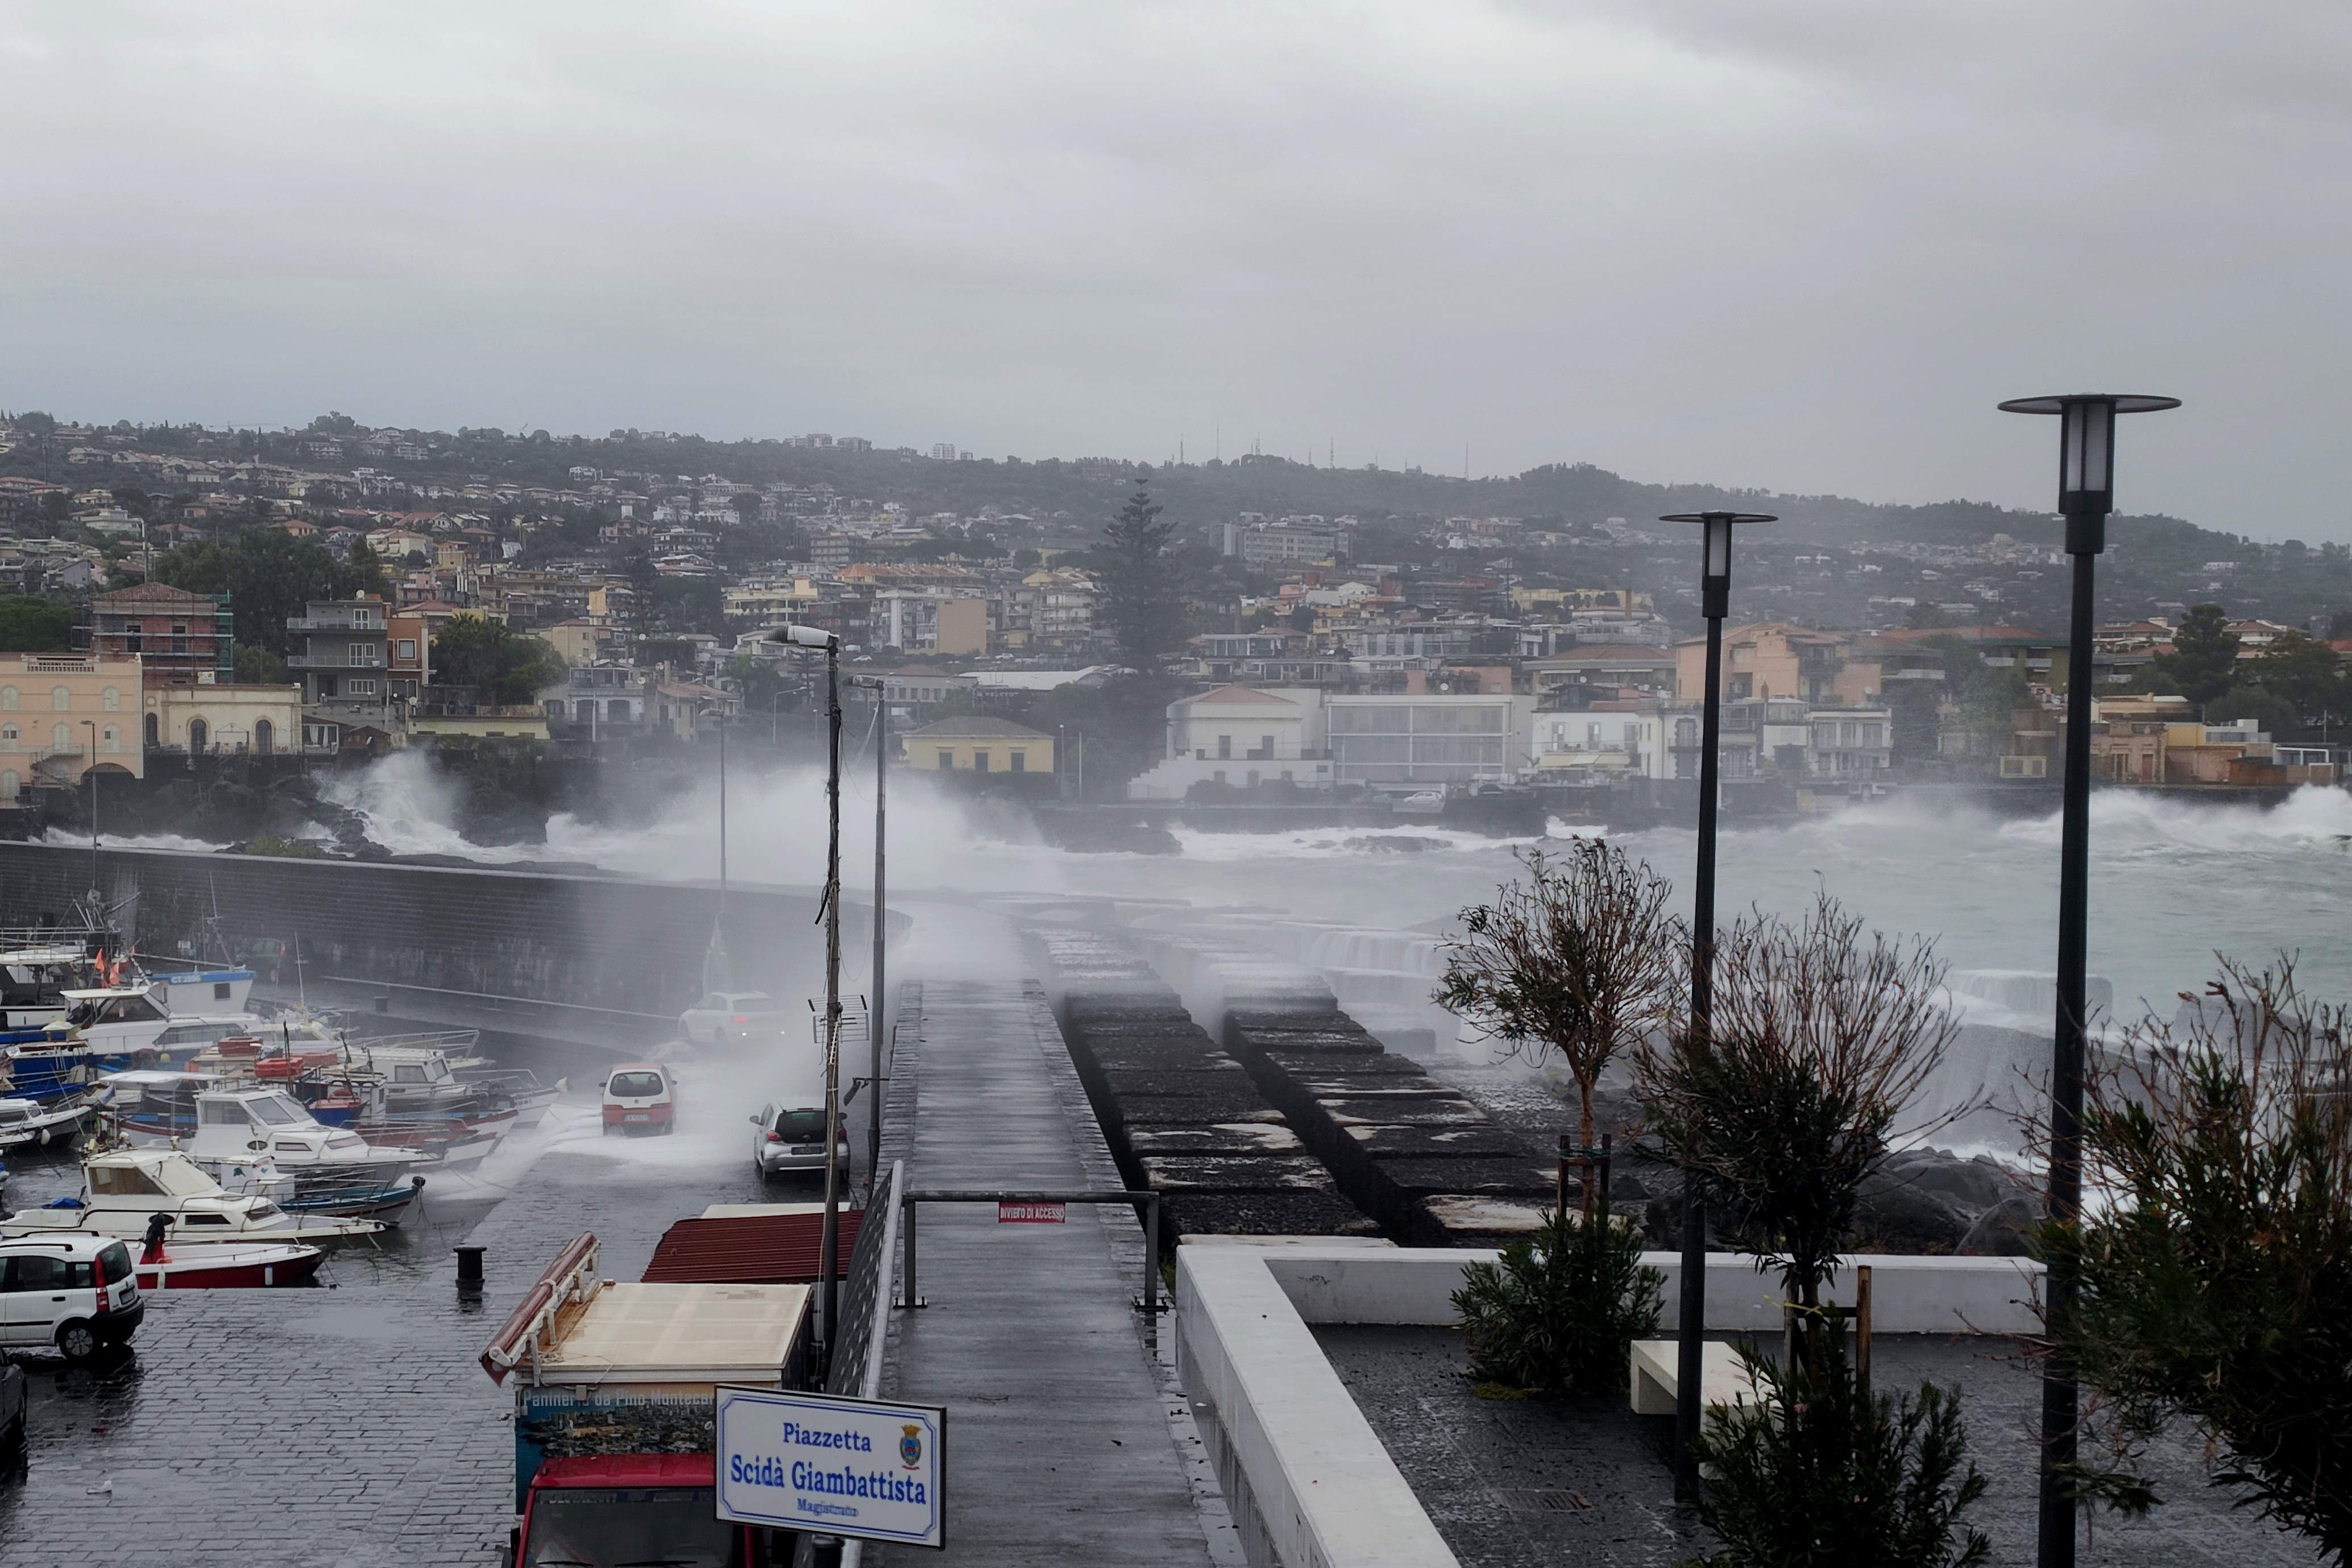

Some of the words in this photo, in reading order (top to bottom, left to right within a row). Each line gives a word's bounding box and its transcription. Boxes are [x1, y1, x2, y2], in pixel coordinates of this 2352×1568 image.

[1000, 1207, 1025, 1219] DIVIETO
[1027, 1208, 1034, 1219] DI
[1035, 1207, 1064, 1219] ACCESSO
[595, 1390, 611, 1406] da
[616, 1388, 645, 1406] Pino
[783, 1422, 872, 1452] Piazzetta
[731, 1454, 784, 1488] Scidà
[792, 1461, 926, 1504] Giambattista
